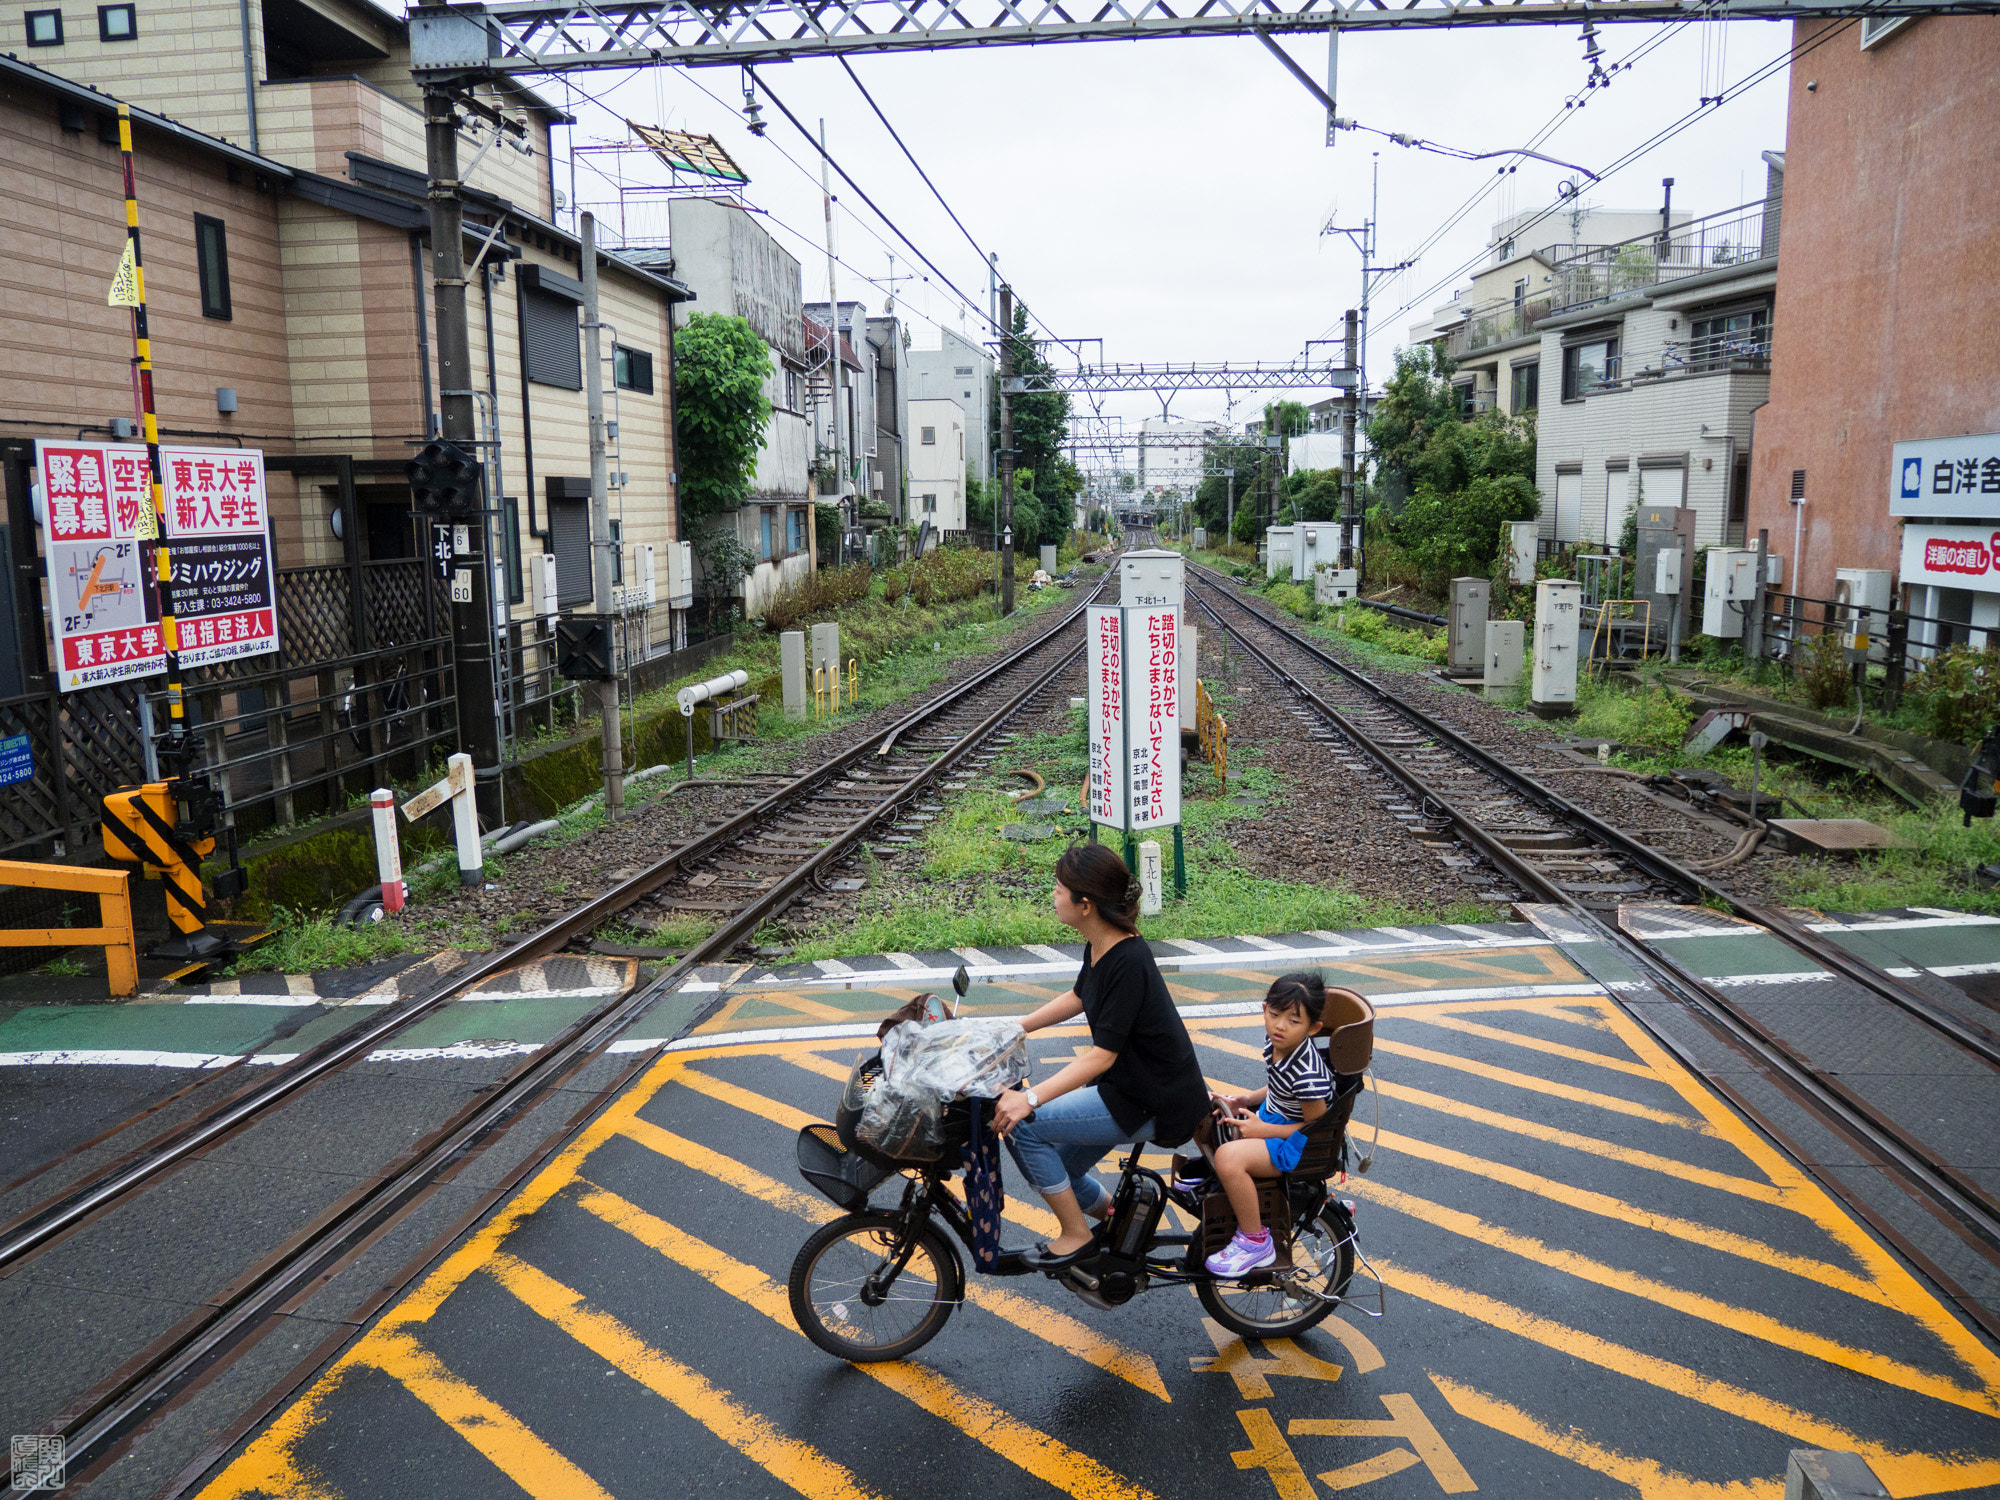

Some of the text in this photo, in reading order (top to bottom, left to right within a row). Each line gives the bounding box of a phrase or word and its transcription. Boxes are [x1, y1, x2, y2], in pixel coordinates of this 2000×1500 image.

[48, 454, 104, 493] 緊急
[171, 459, 257, 493] 東京大学
[51, 495, 108, 536] 募集
[175, 495, 260, 530] 新入学生
[116, 543, 131, 558] 2F
[456, 535, 463, 546] 6
[1926, 545, 1988, 568] 洋服のお直し
[454, 587, 469, 600] 60
[1135, 596, 1167, 605] 下北1-1
[65, 615, 81, 632] 2F
[1110, 616, 1120, 721] 踏切のなかで
[1161, 614, 1175, 718] 踏切のなかで
[684, 704, 691, 713] 4
[1100, 615, 1112, 818] たちどまらないでください
[1148, 615, 1163, 819] たちどまらないでください
